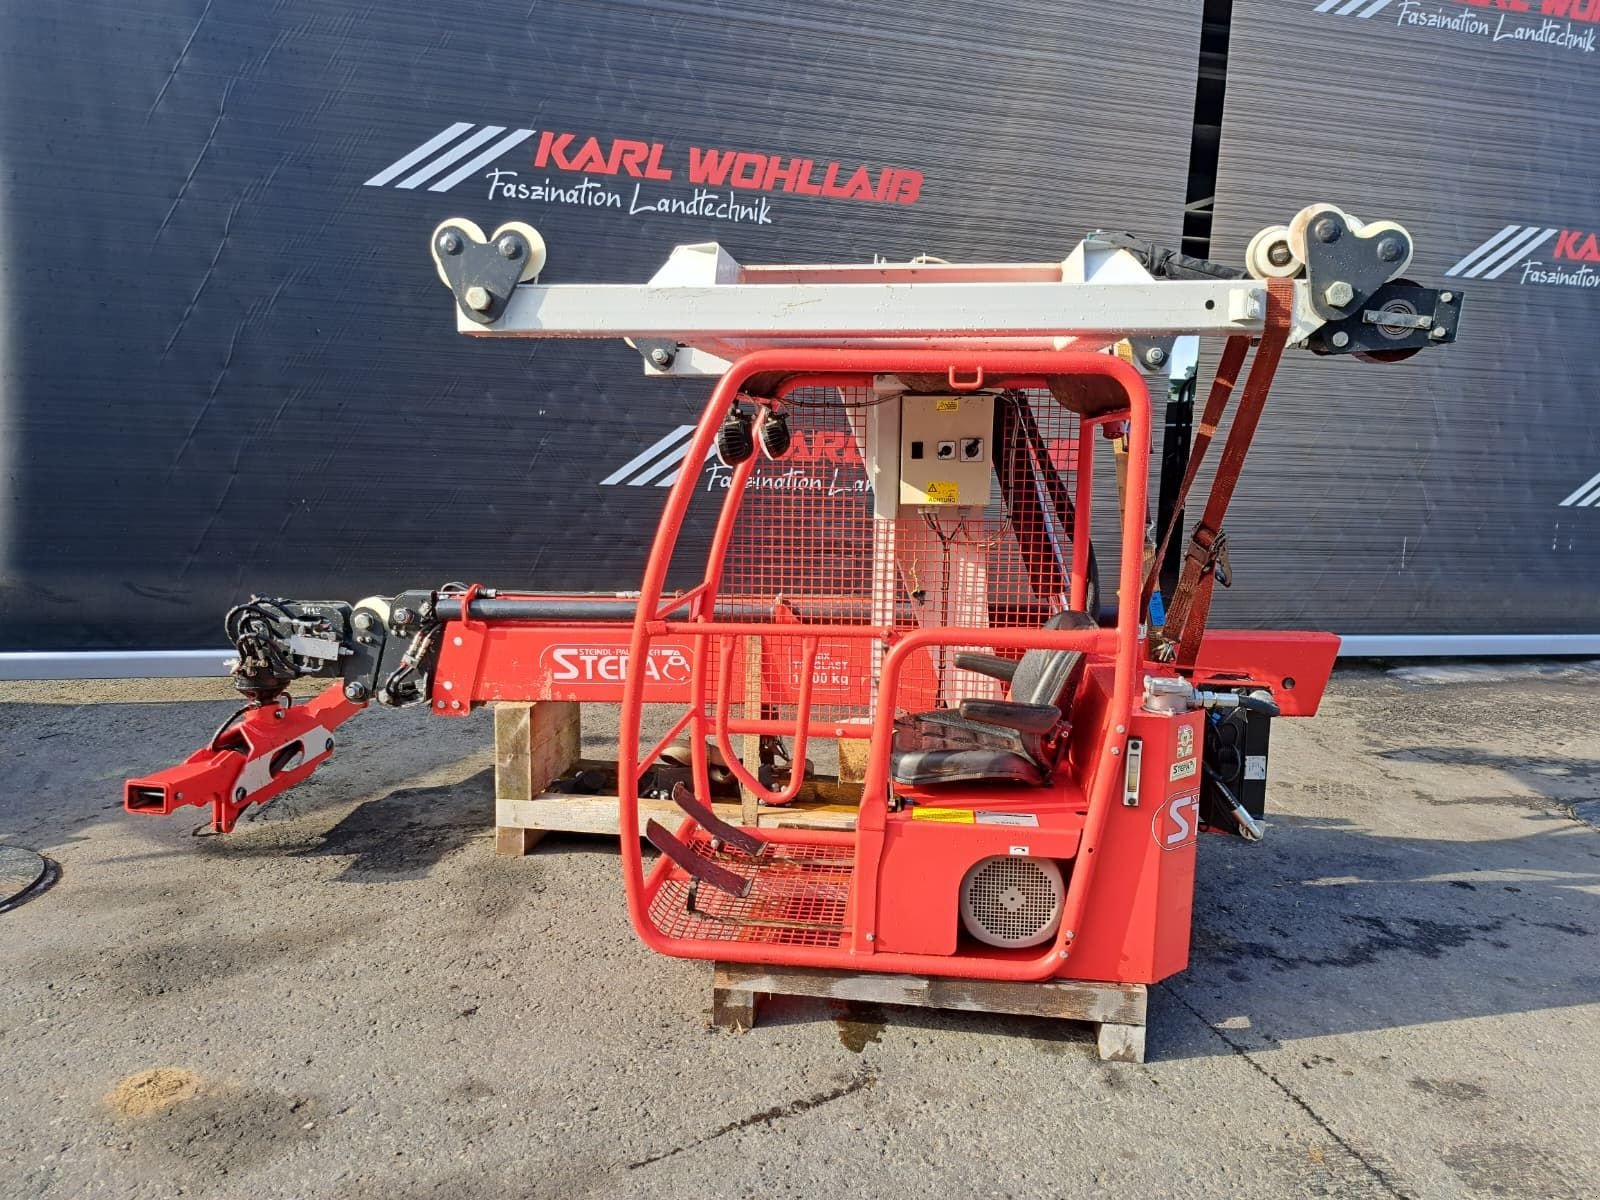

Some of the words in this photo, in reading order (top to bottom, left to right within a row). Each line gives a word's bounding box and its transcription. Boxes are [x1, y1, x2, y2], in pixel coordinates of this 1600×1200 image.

[1397, 2, 1489, 35] Faszination
[1493, 14, 1596, 52] Landtechnik
[534, 131, 673, 180] KARL
[689, 146, 924, 205] WOHLLAIB
[486, 167, 621, 208] Faszination
[629, 183, 772, 224] Landtechnik
[705, 464, 822, 491] Fazination
[792, 661, 848, 670] TGLAST
[832, 673, 849, 686] kg
